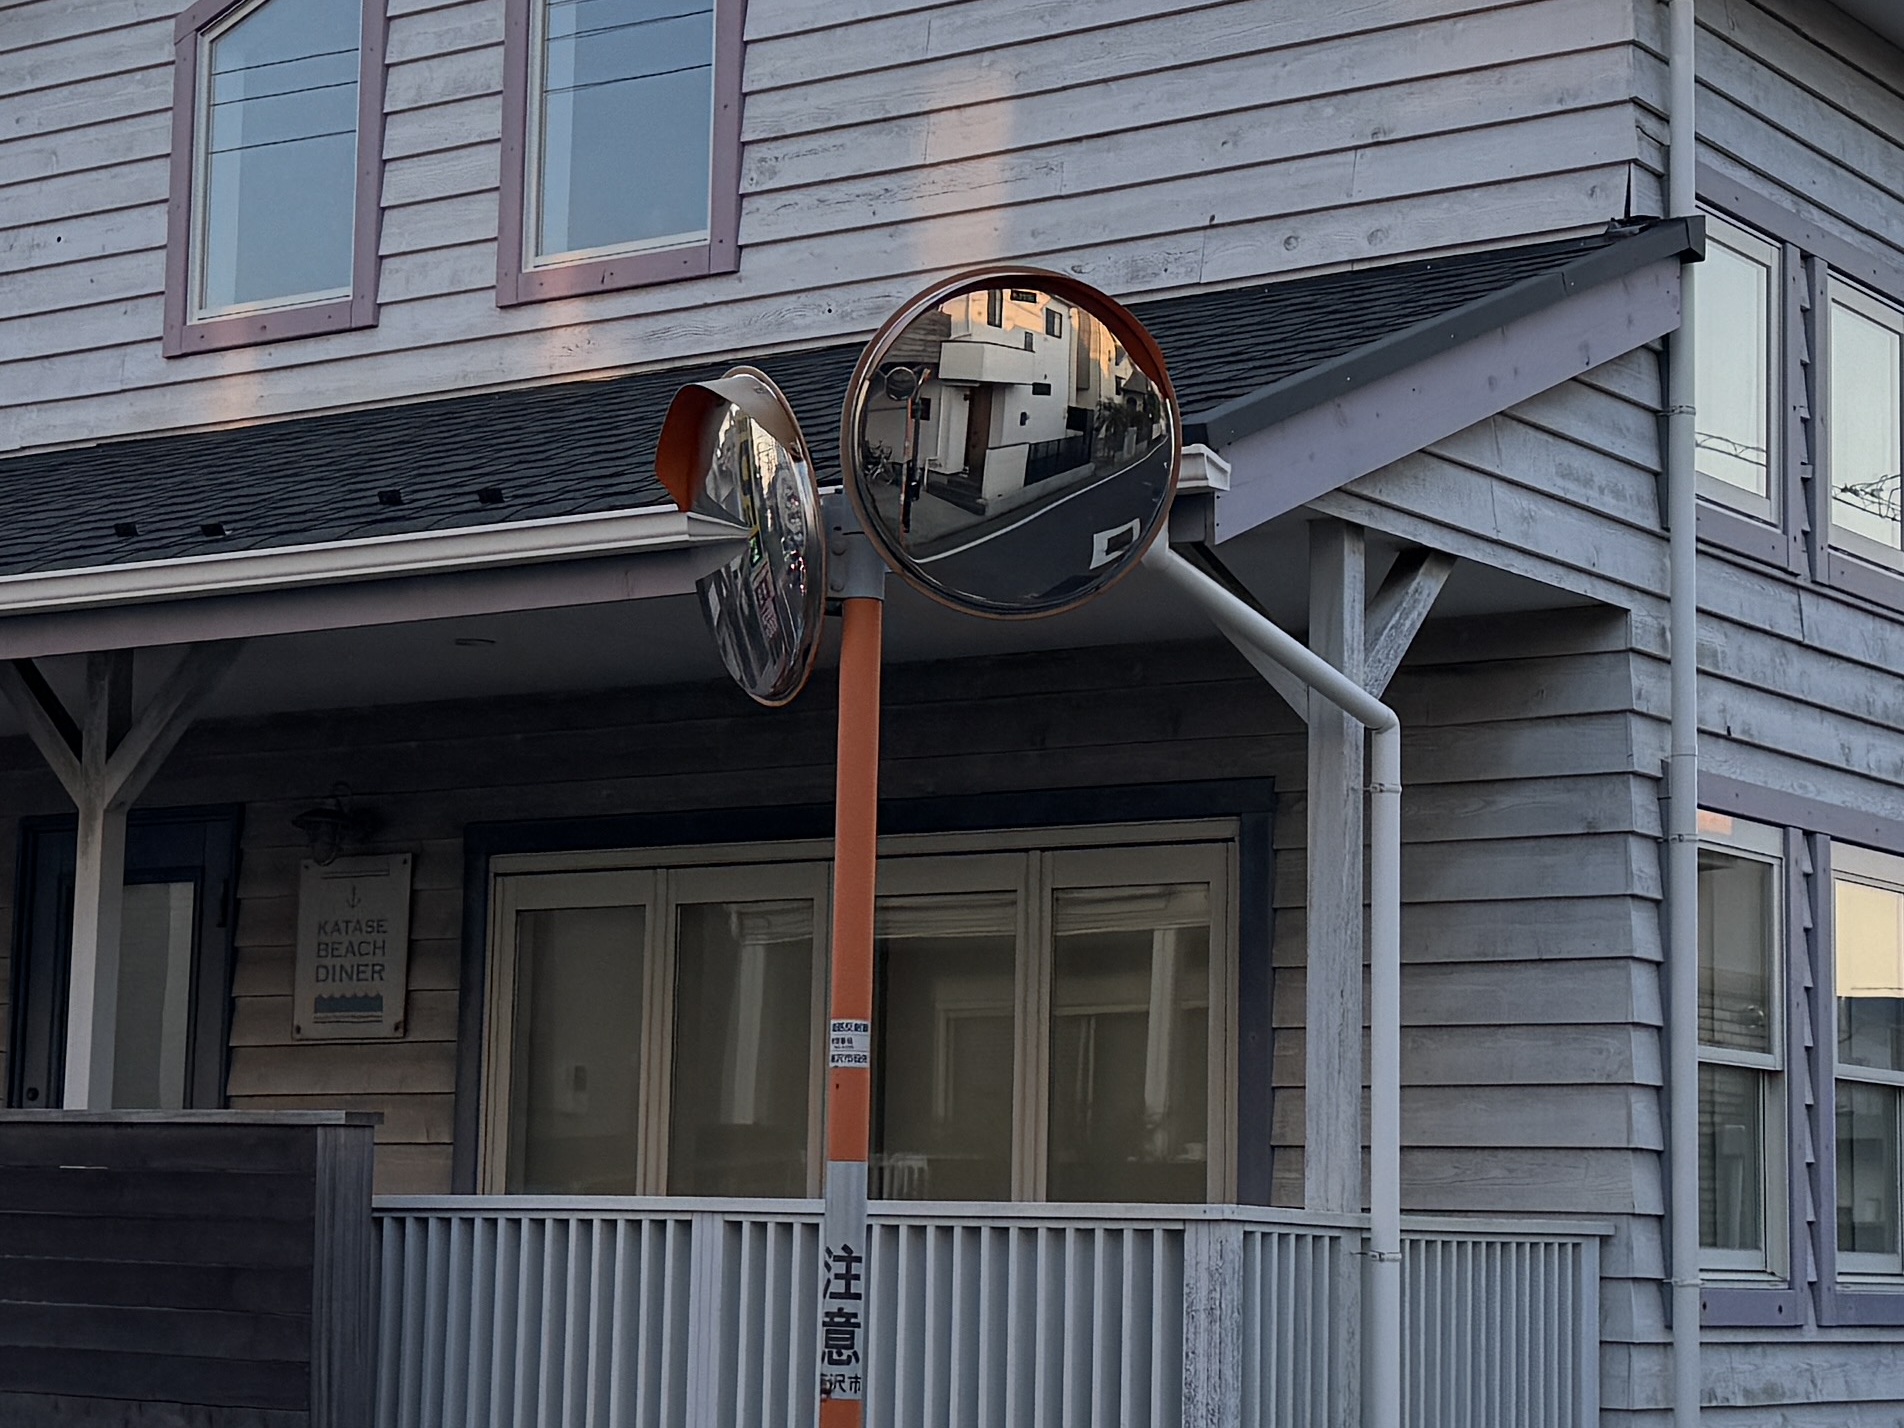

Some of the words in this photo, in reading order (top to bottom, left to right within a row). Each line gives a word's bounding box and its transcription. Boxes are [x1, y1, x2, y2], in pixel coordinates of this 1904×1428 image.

[318, 919, 388, 936] KATASE
[316, 940, 386, 958] BEACH
[315, 963, 386, 983] DINER
[821, 1243, 863, 1366] 注意
[820, 1373, 862, 1394] 沢市
